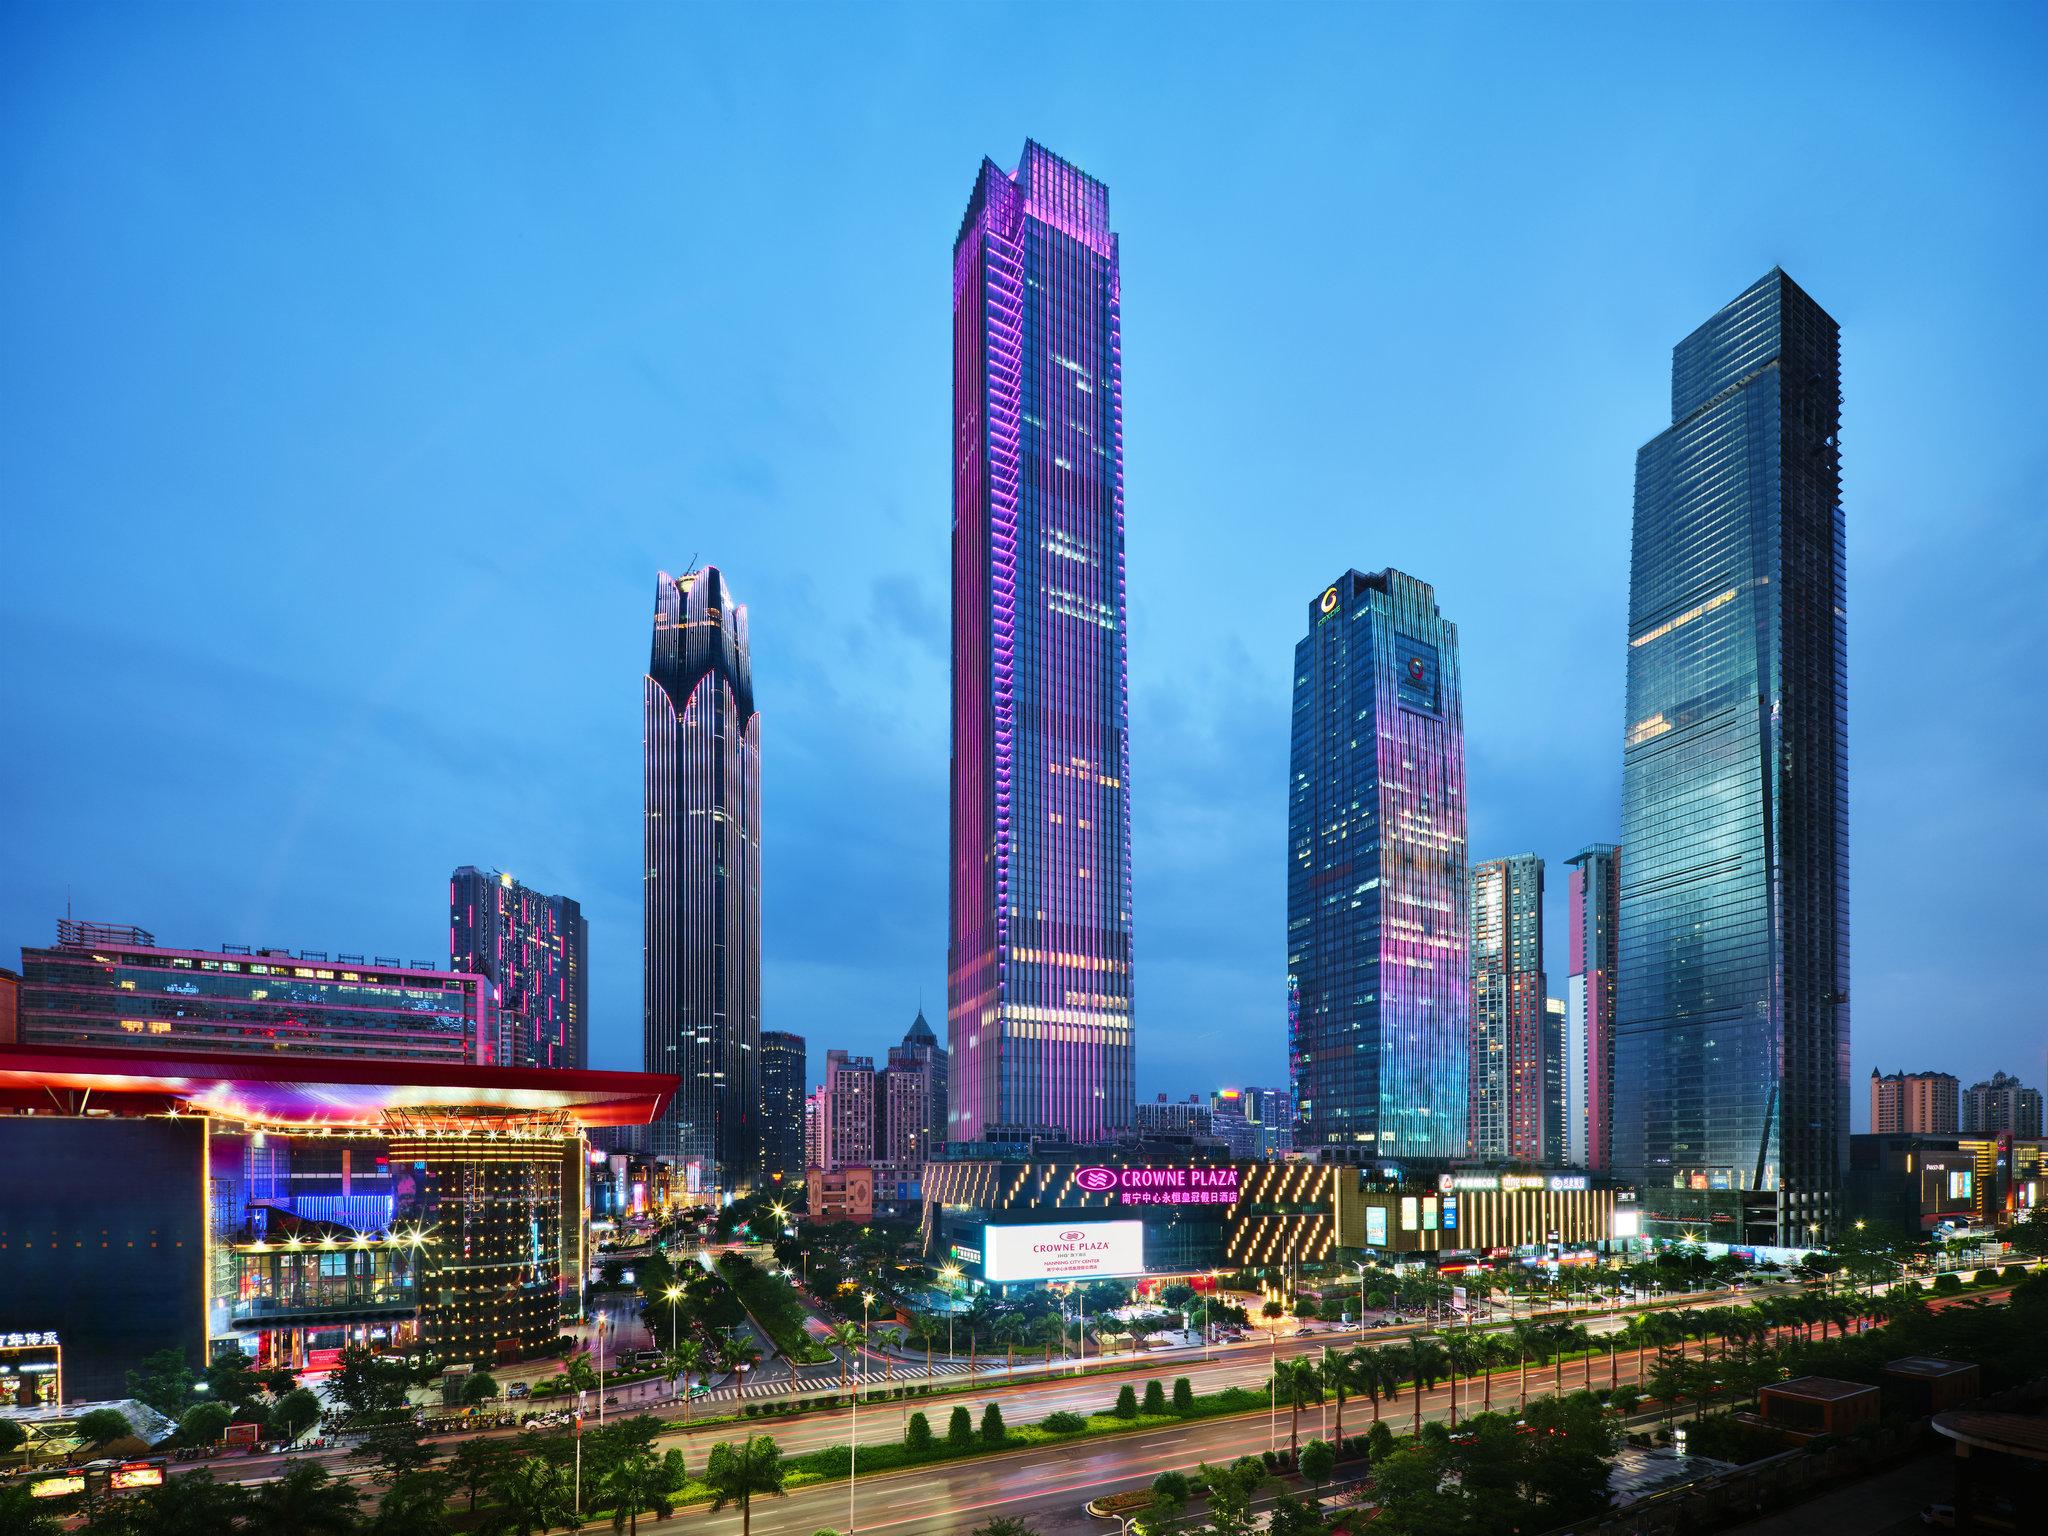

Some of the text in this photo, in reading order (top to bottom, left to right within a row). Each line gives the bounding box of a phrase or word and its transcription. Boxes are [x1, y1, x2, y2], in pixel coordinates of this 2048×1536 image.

[1122, 1170, 1237, 1187] CROWNE PLAZA
[1122, 1192, 1238, 1204] 南宁中心永恒皇冠假日酒店
[1033, 1241, 1109, 1253] CROWNE PLAZA
